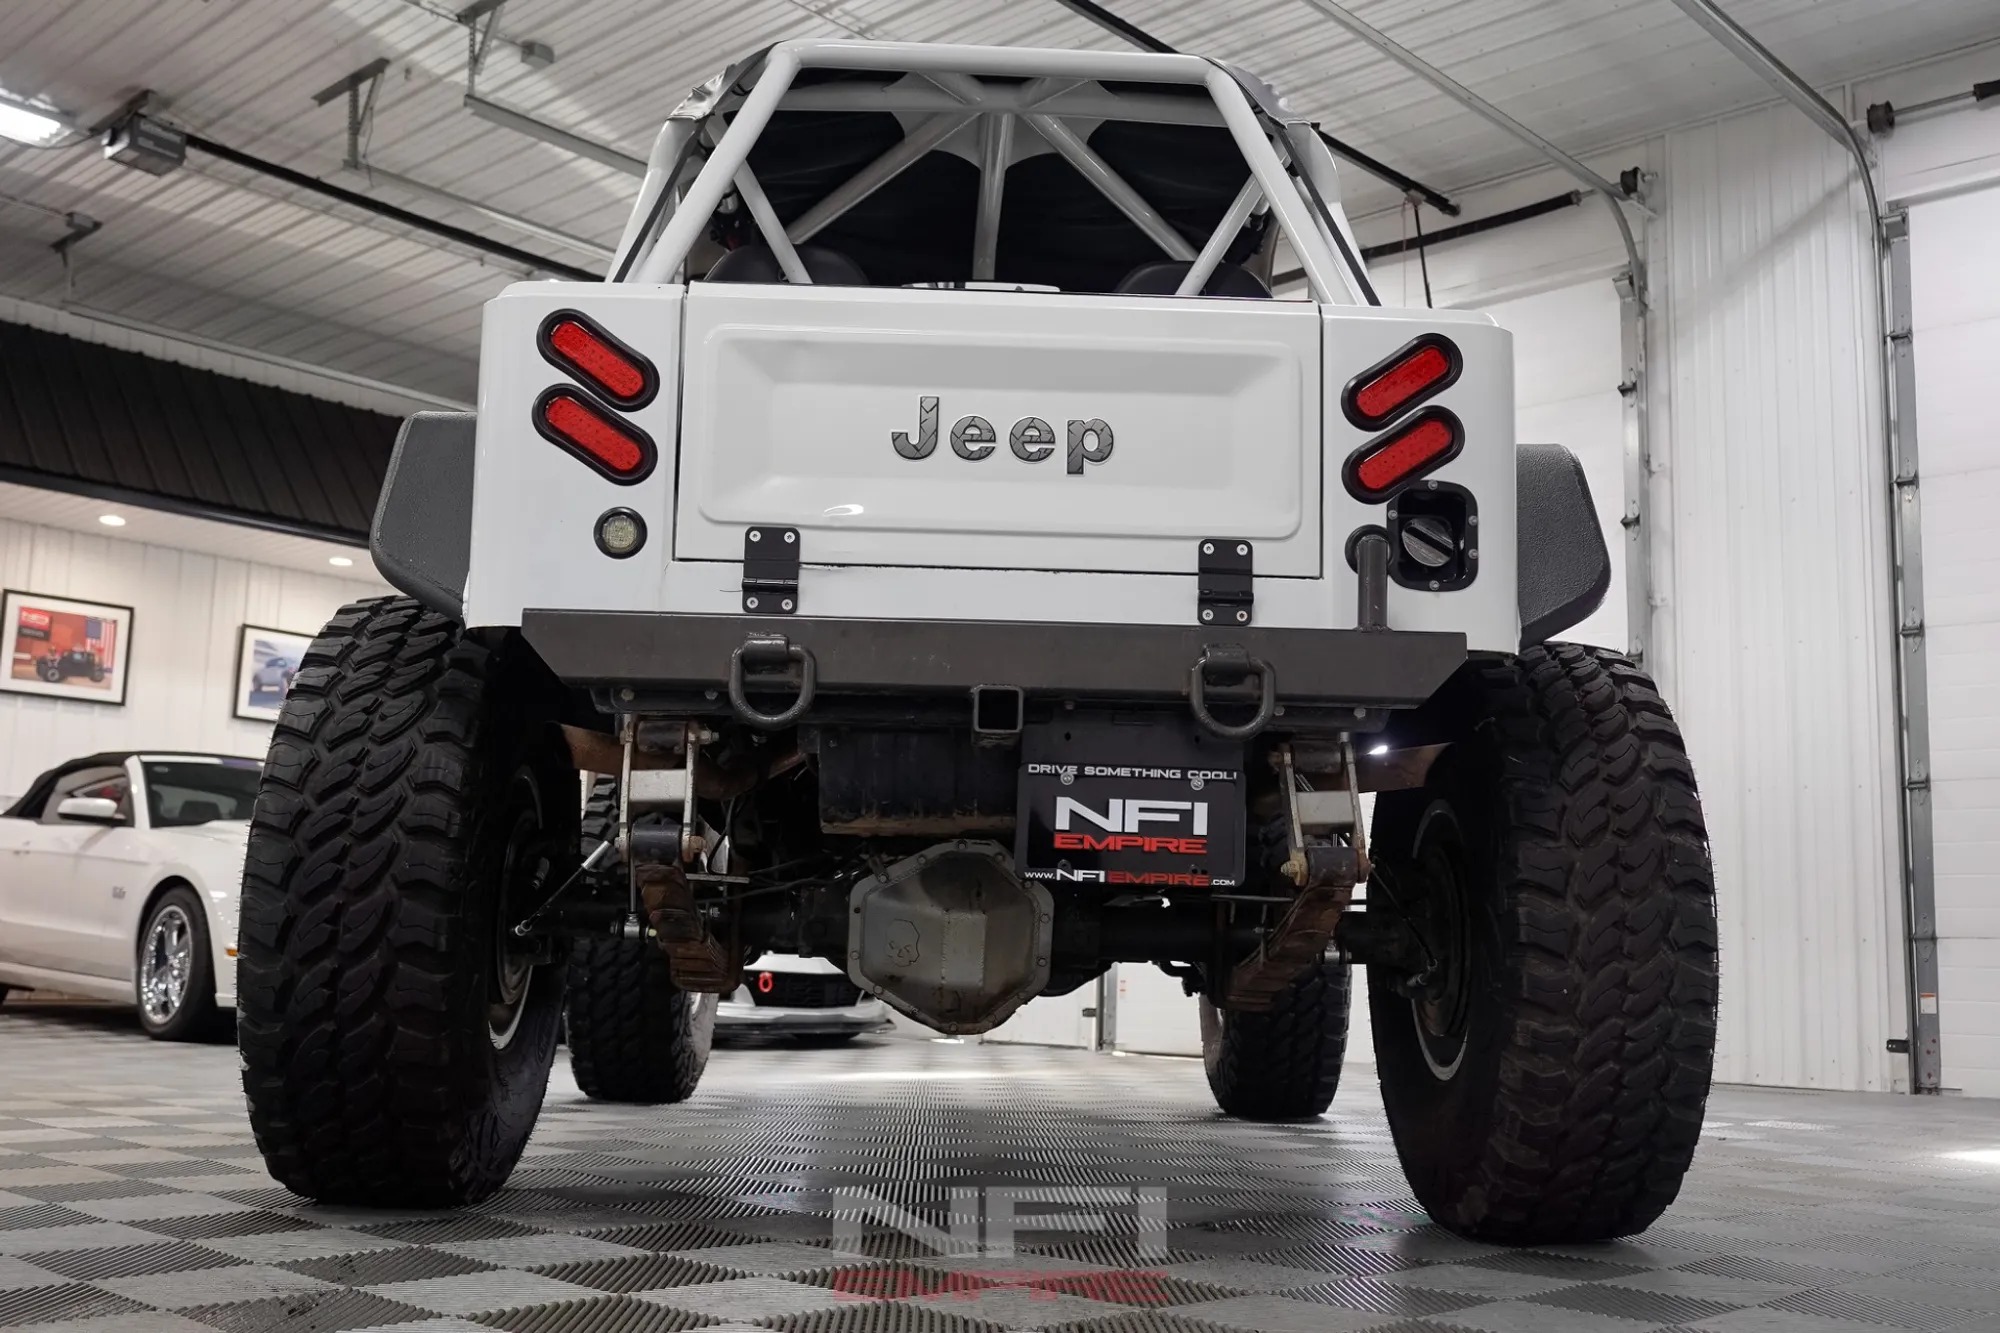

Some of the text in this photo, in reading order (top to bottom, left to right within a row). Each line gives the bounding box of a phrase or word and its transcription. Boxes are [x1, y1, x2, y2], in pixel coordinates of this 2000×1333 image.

[891, 395, 1114, 475] Jeep
[1028, 763, 1237, 780] DRIVE SOMETHING COOL!
[1055, 796, 1208, 836] NFI
[1053, 832, 1208, 854] EMPIRE
